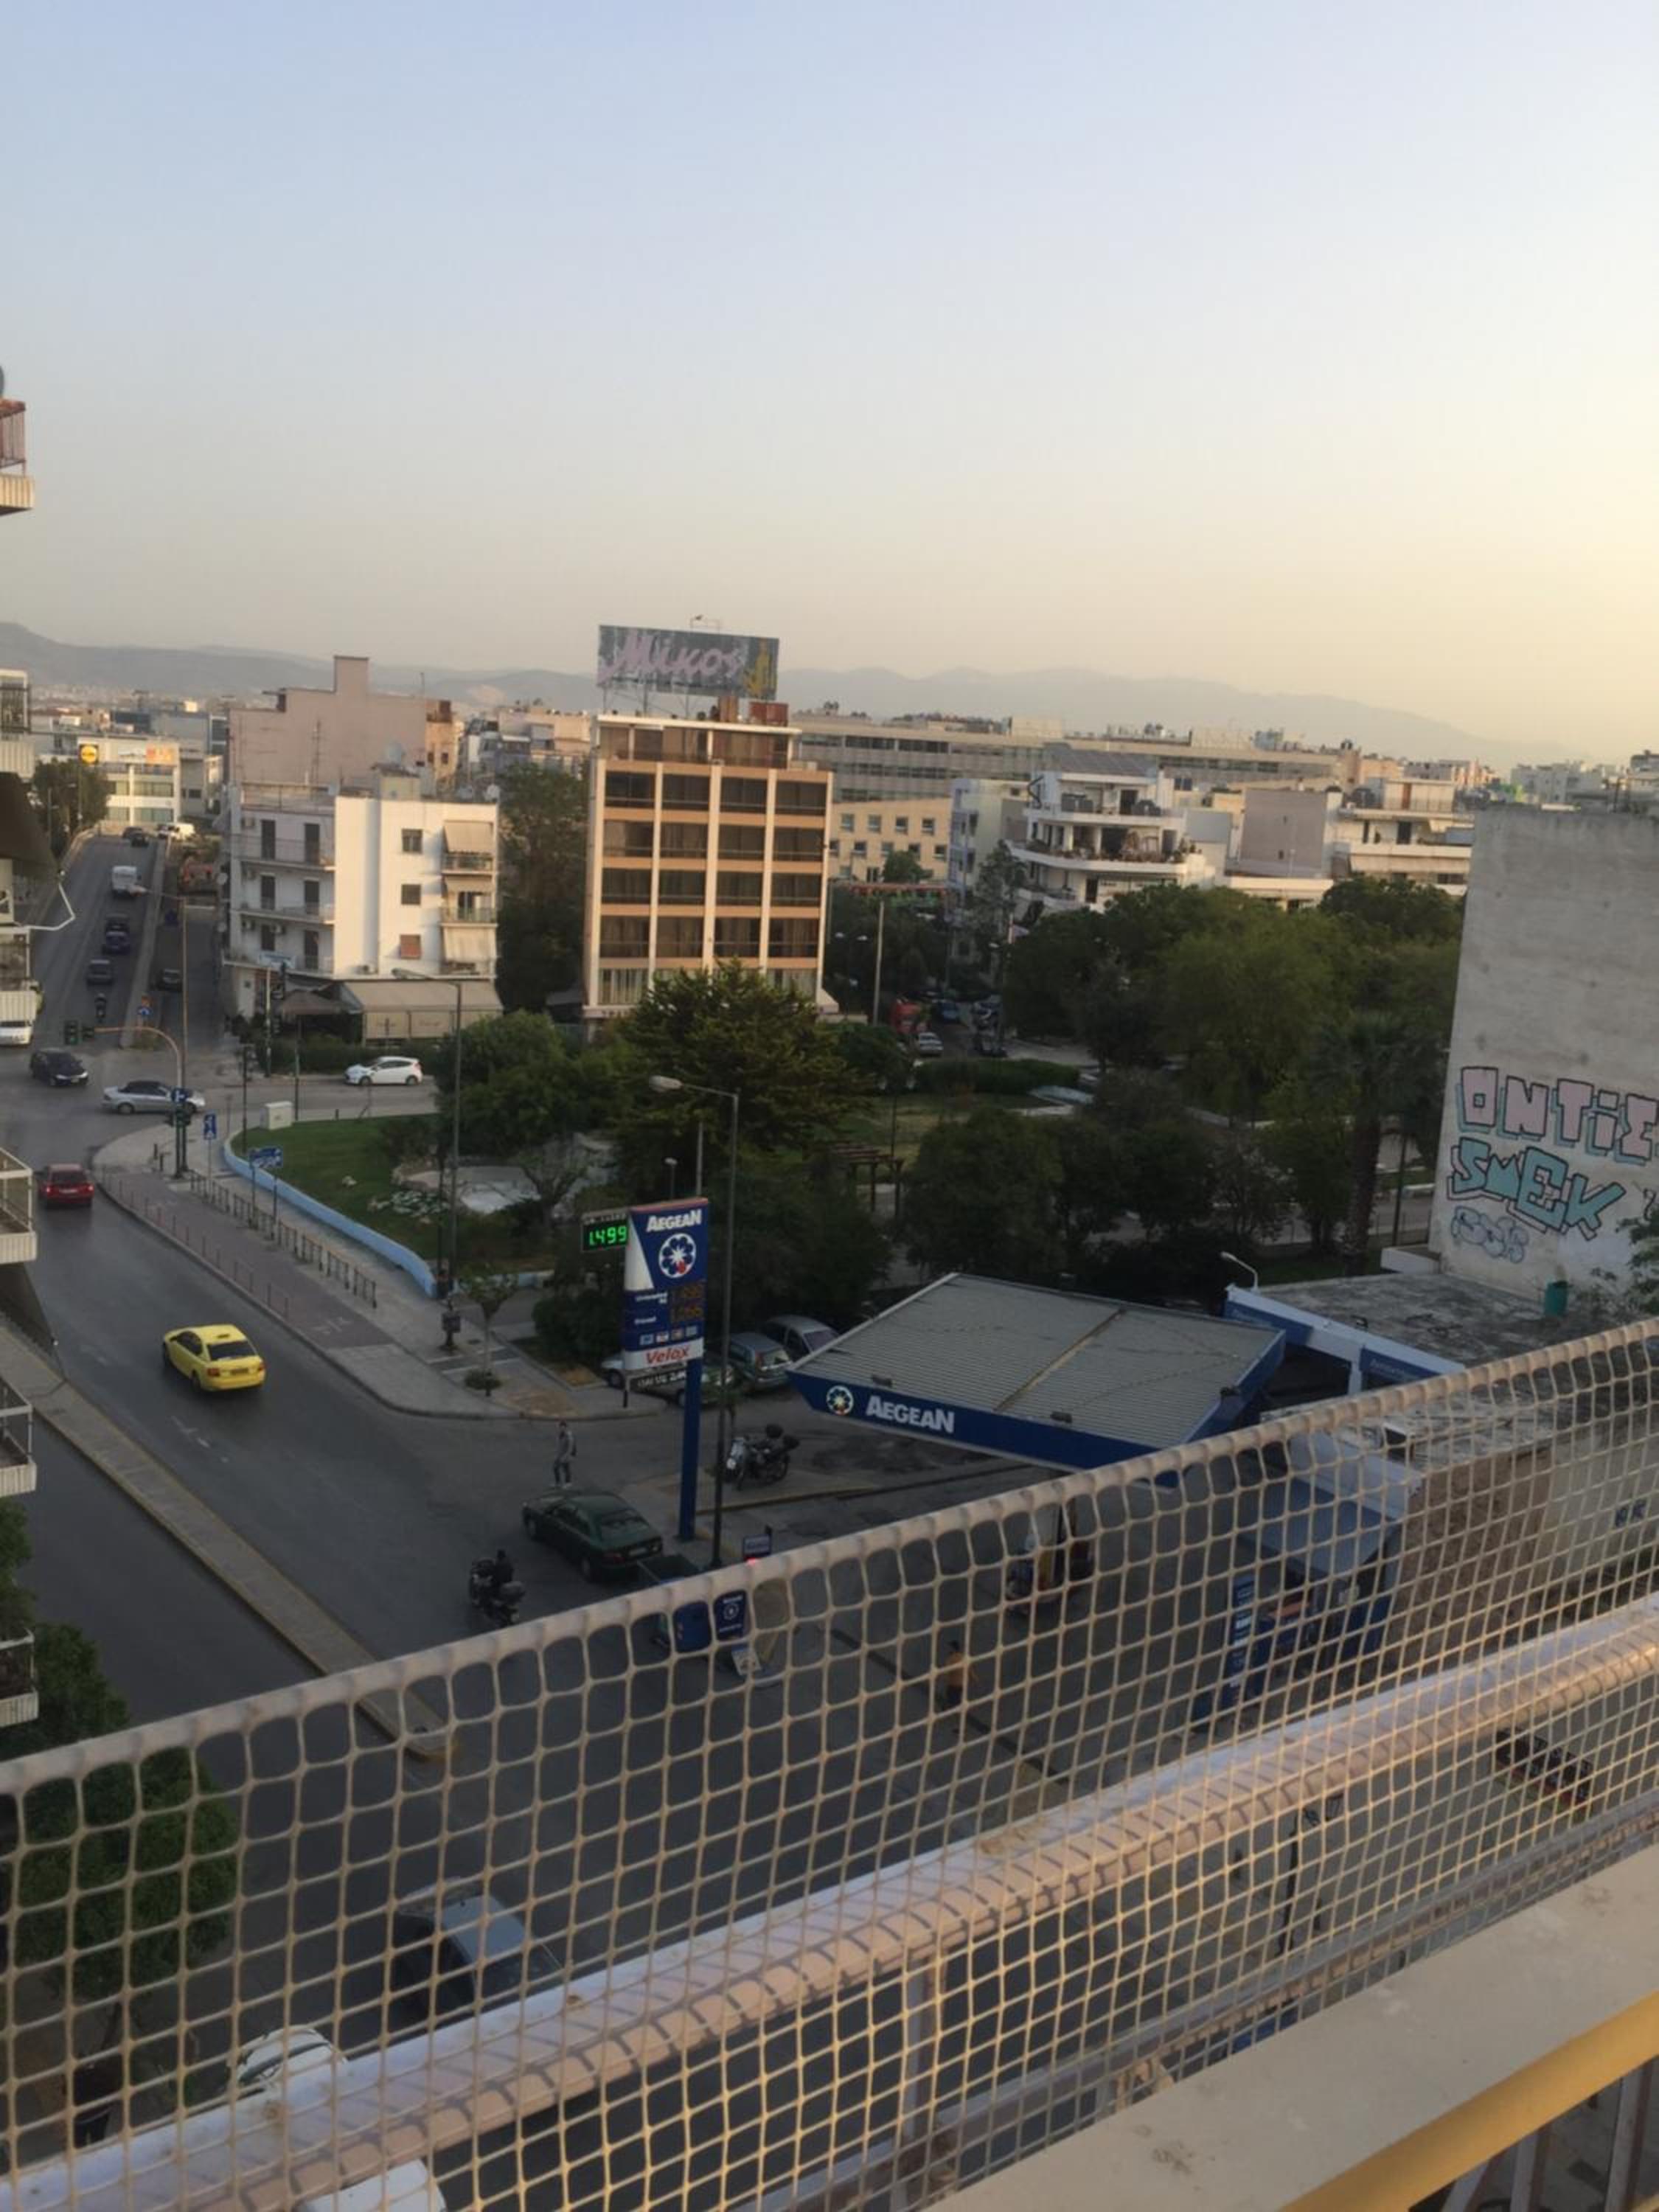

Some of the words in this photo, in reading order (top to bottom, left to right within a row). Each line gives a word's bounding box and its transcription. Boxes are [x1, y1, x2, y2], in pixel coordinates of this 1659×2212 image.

[646, 1209, 702, 1232] AEGEAN
[646, 1345, 690, 1364] Velox
[866, 1395, 955, 1434] AEGEAN
